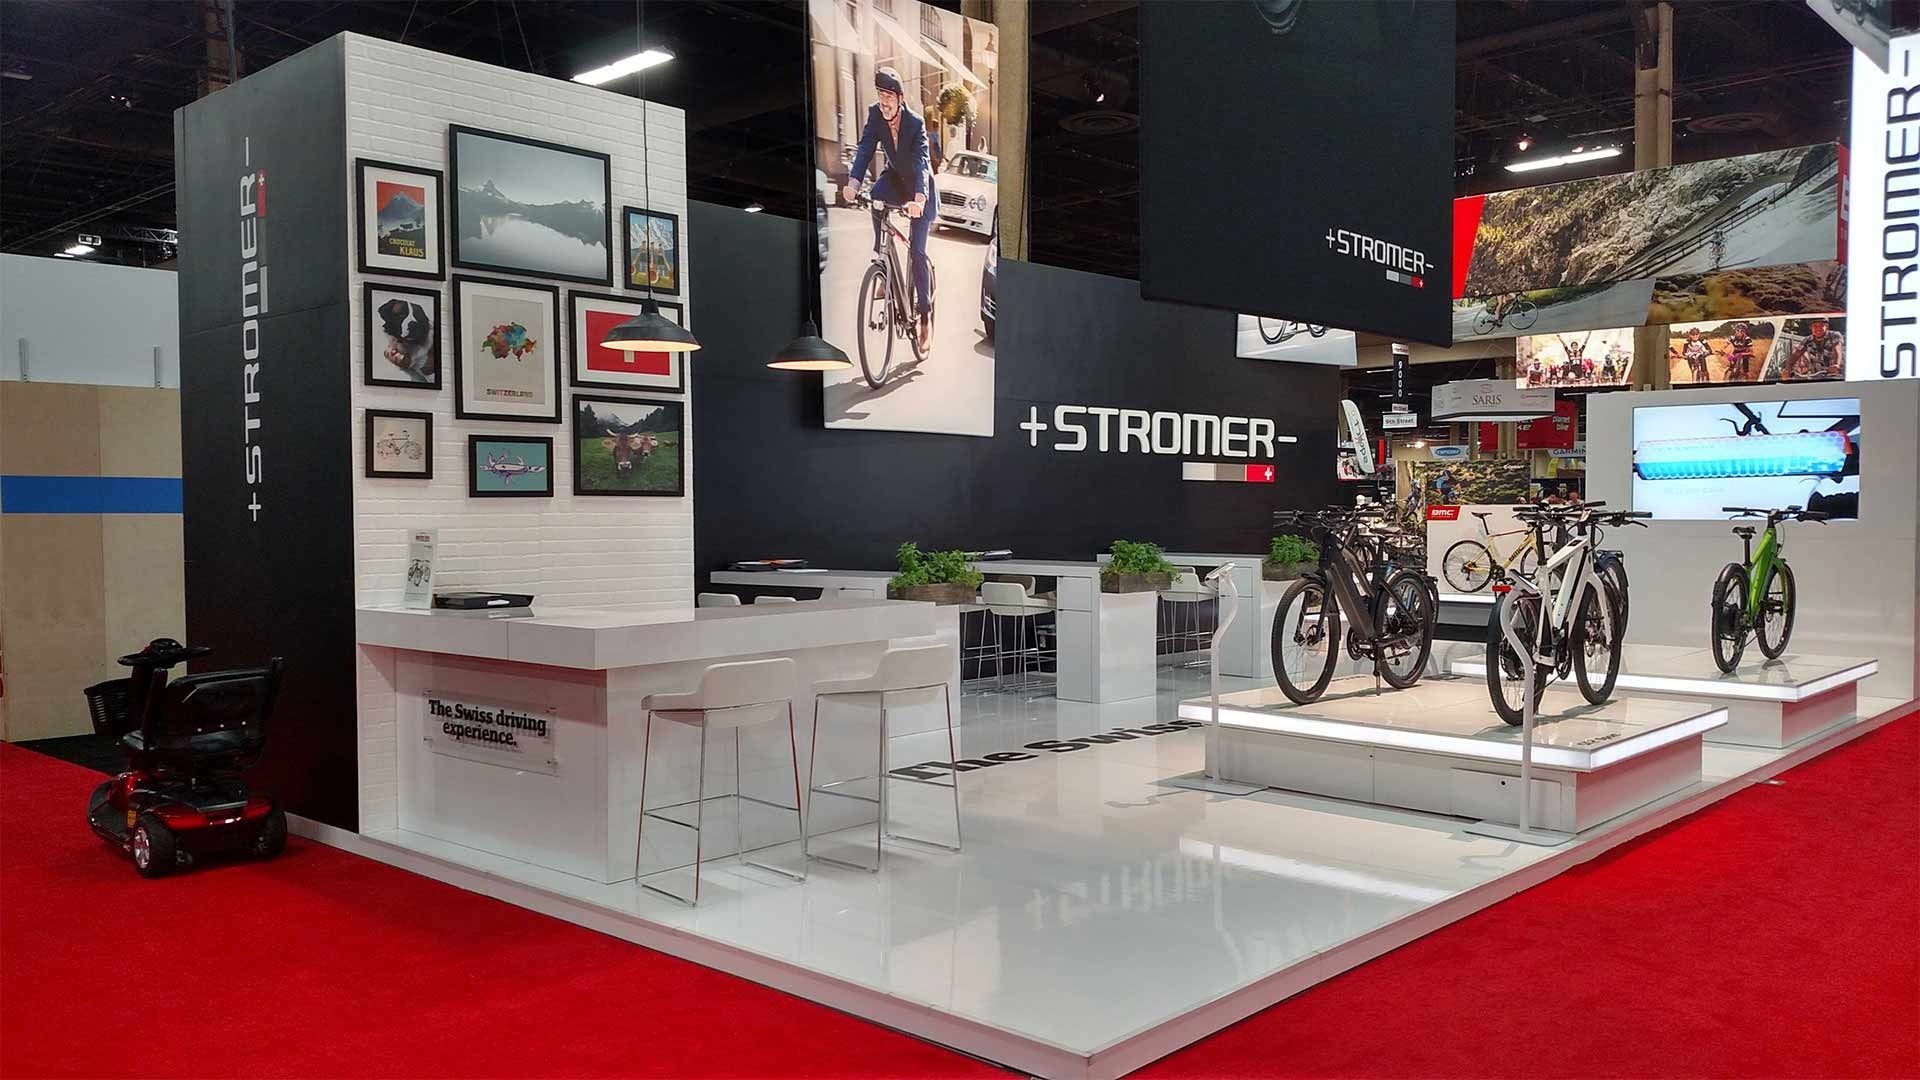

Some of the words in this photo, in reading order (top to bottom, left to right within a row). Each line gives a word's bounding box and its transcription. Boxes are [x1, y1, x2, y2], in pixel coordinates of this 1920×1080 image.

[400, 246, 424, 257] KLAUS
[1472, 394, 1502, 406] SARIS
[1431, 508, 1455, 517] BMC
[428, 699, 453, 718] The
[454, 703, 494, 725] Swiss
[495, 709, 547, 737] driving
[442, 720, 518, 746] experience.
